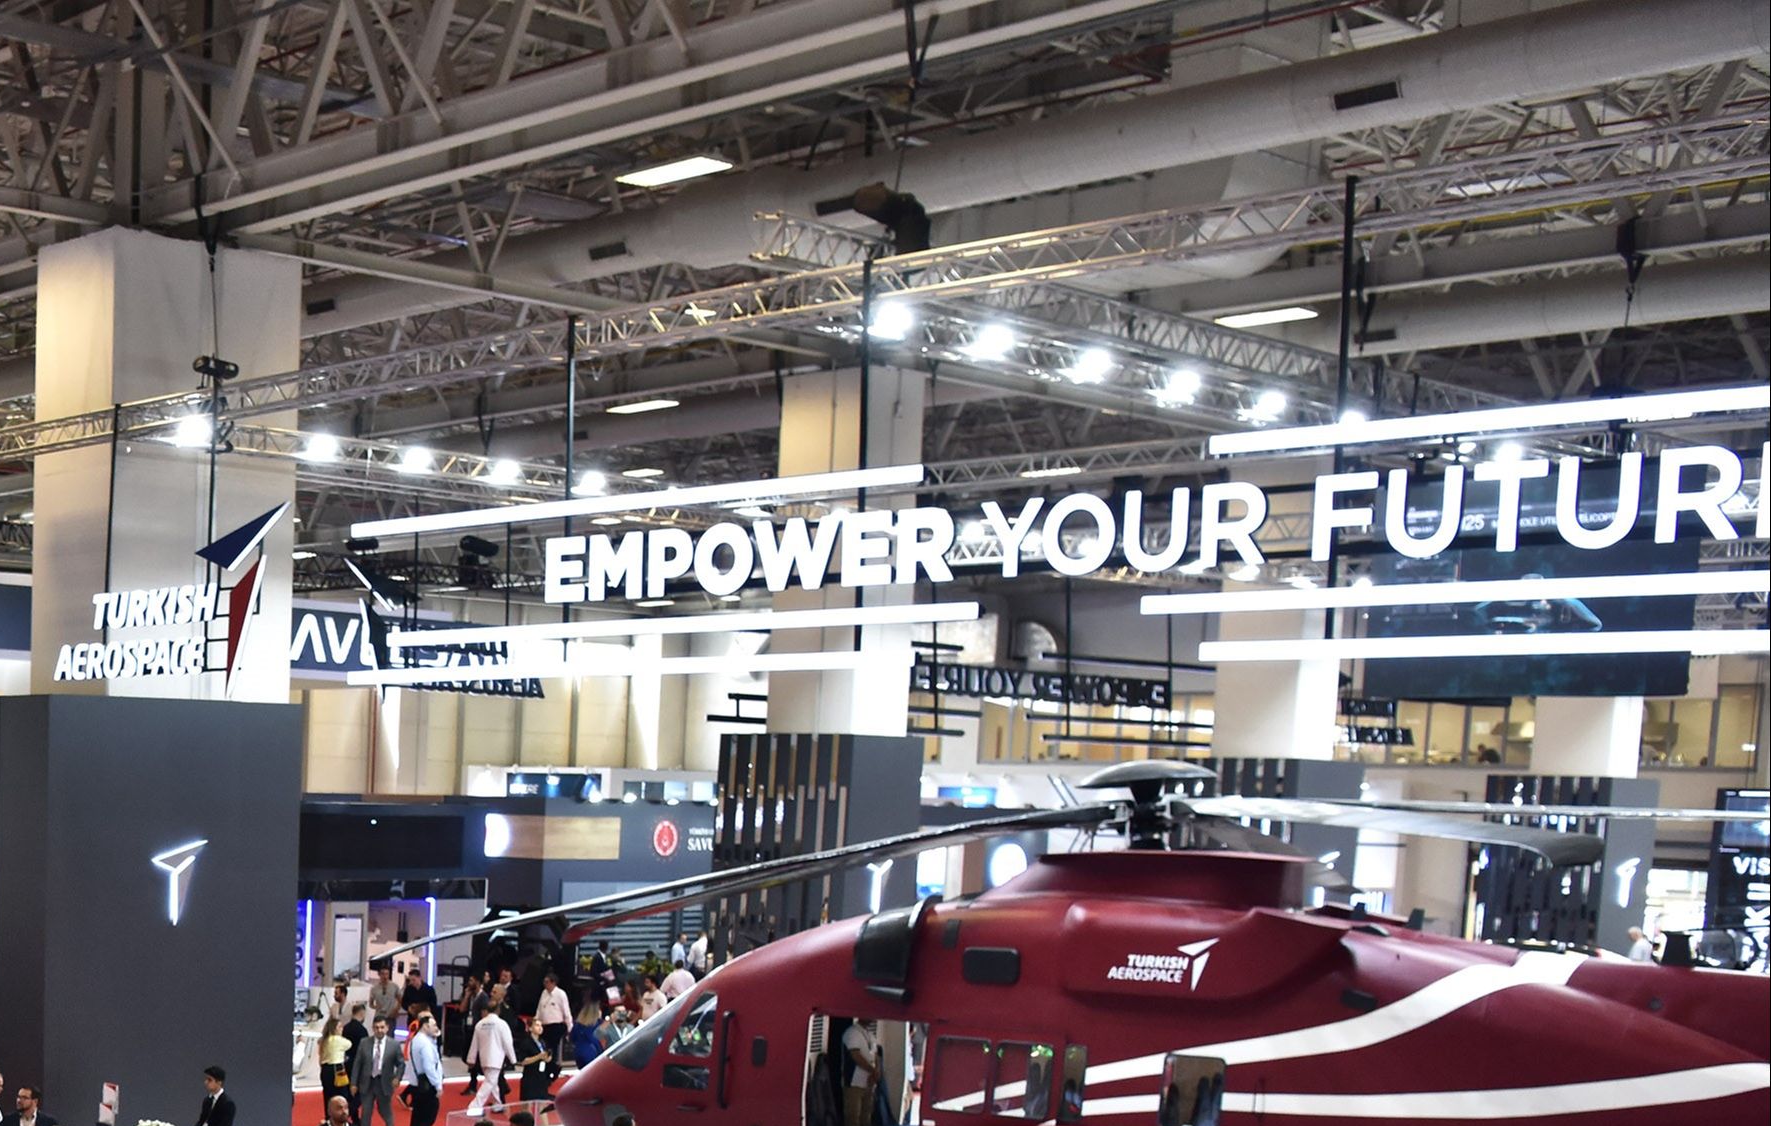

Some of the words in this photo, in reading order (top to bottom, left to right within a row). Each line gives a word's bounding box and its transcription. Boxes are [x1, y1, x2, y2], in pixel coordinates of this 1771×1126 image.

[544, 507, 955, 604] EMPOWER
[980, 481, 1266, 578] YOUR
[93, 583, 217, 630] TURKISH
[54, 636, 205, 681] AEROSPACE
[1107, 966, 1184, 983] AEROSPACE
[1127, 953, 1189, 970] TURKISH
